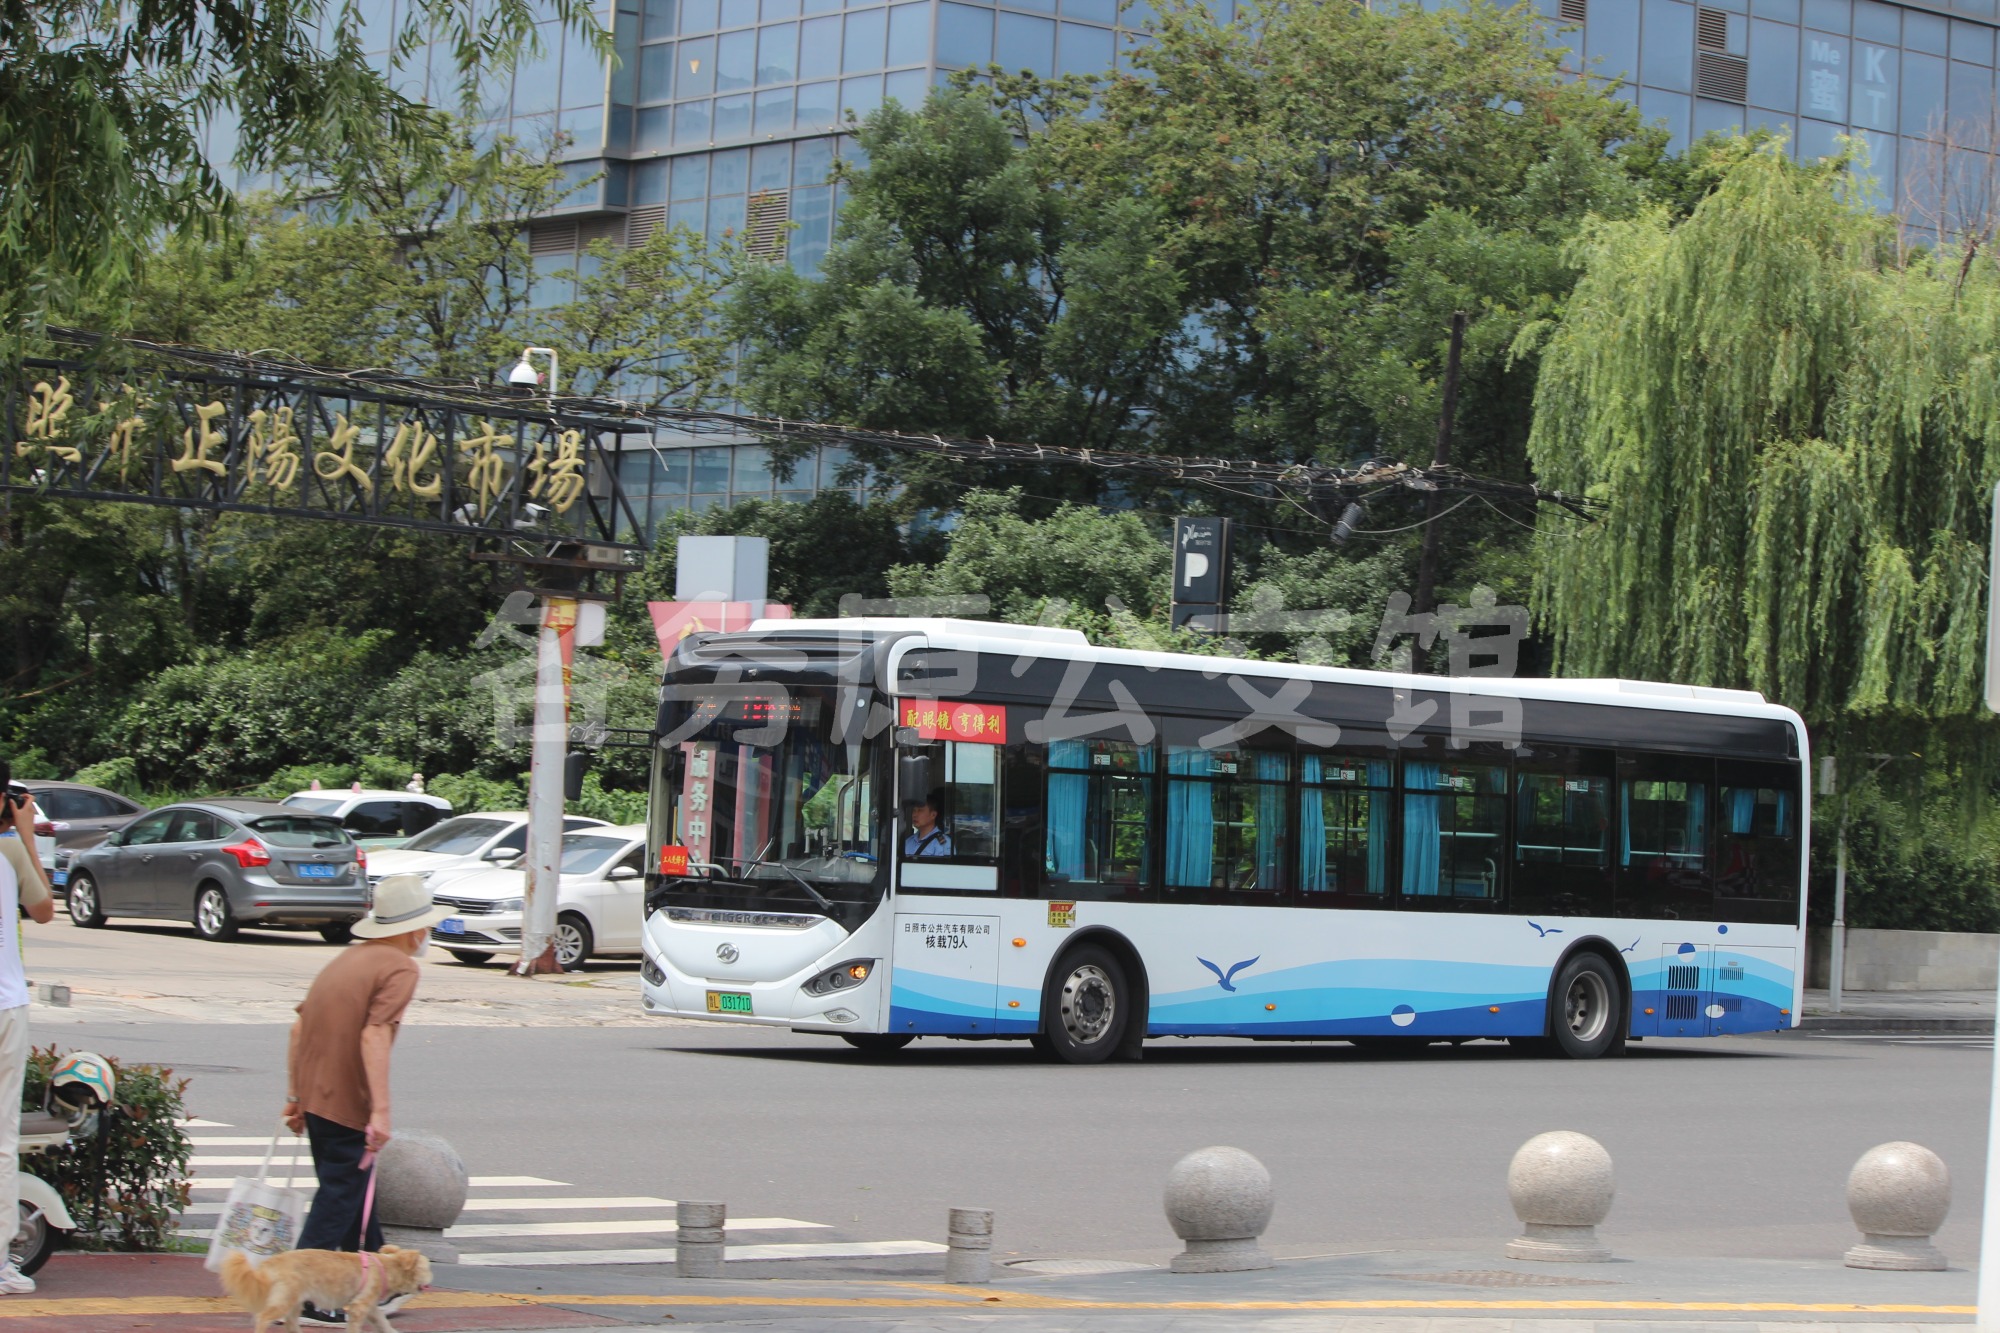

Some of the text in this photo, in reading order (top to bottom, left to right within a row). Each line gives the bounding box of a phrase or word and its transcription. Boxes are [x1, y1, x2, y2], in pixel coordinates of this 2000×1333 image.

[1811, 40, 1840, 65] Me
[1184, 552, 1209, 587] P
[906, 709, 1000, 735] 配眼镜 亨得利
[904, 923, 990, 935] 日照市公共汽车有限公司
[925, 935, 968, 949] 核载79人
